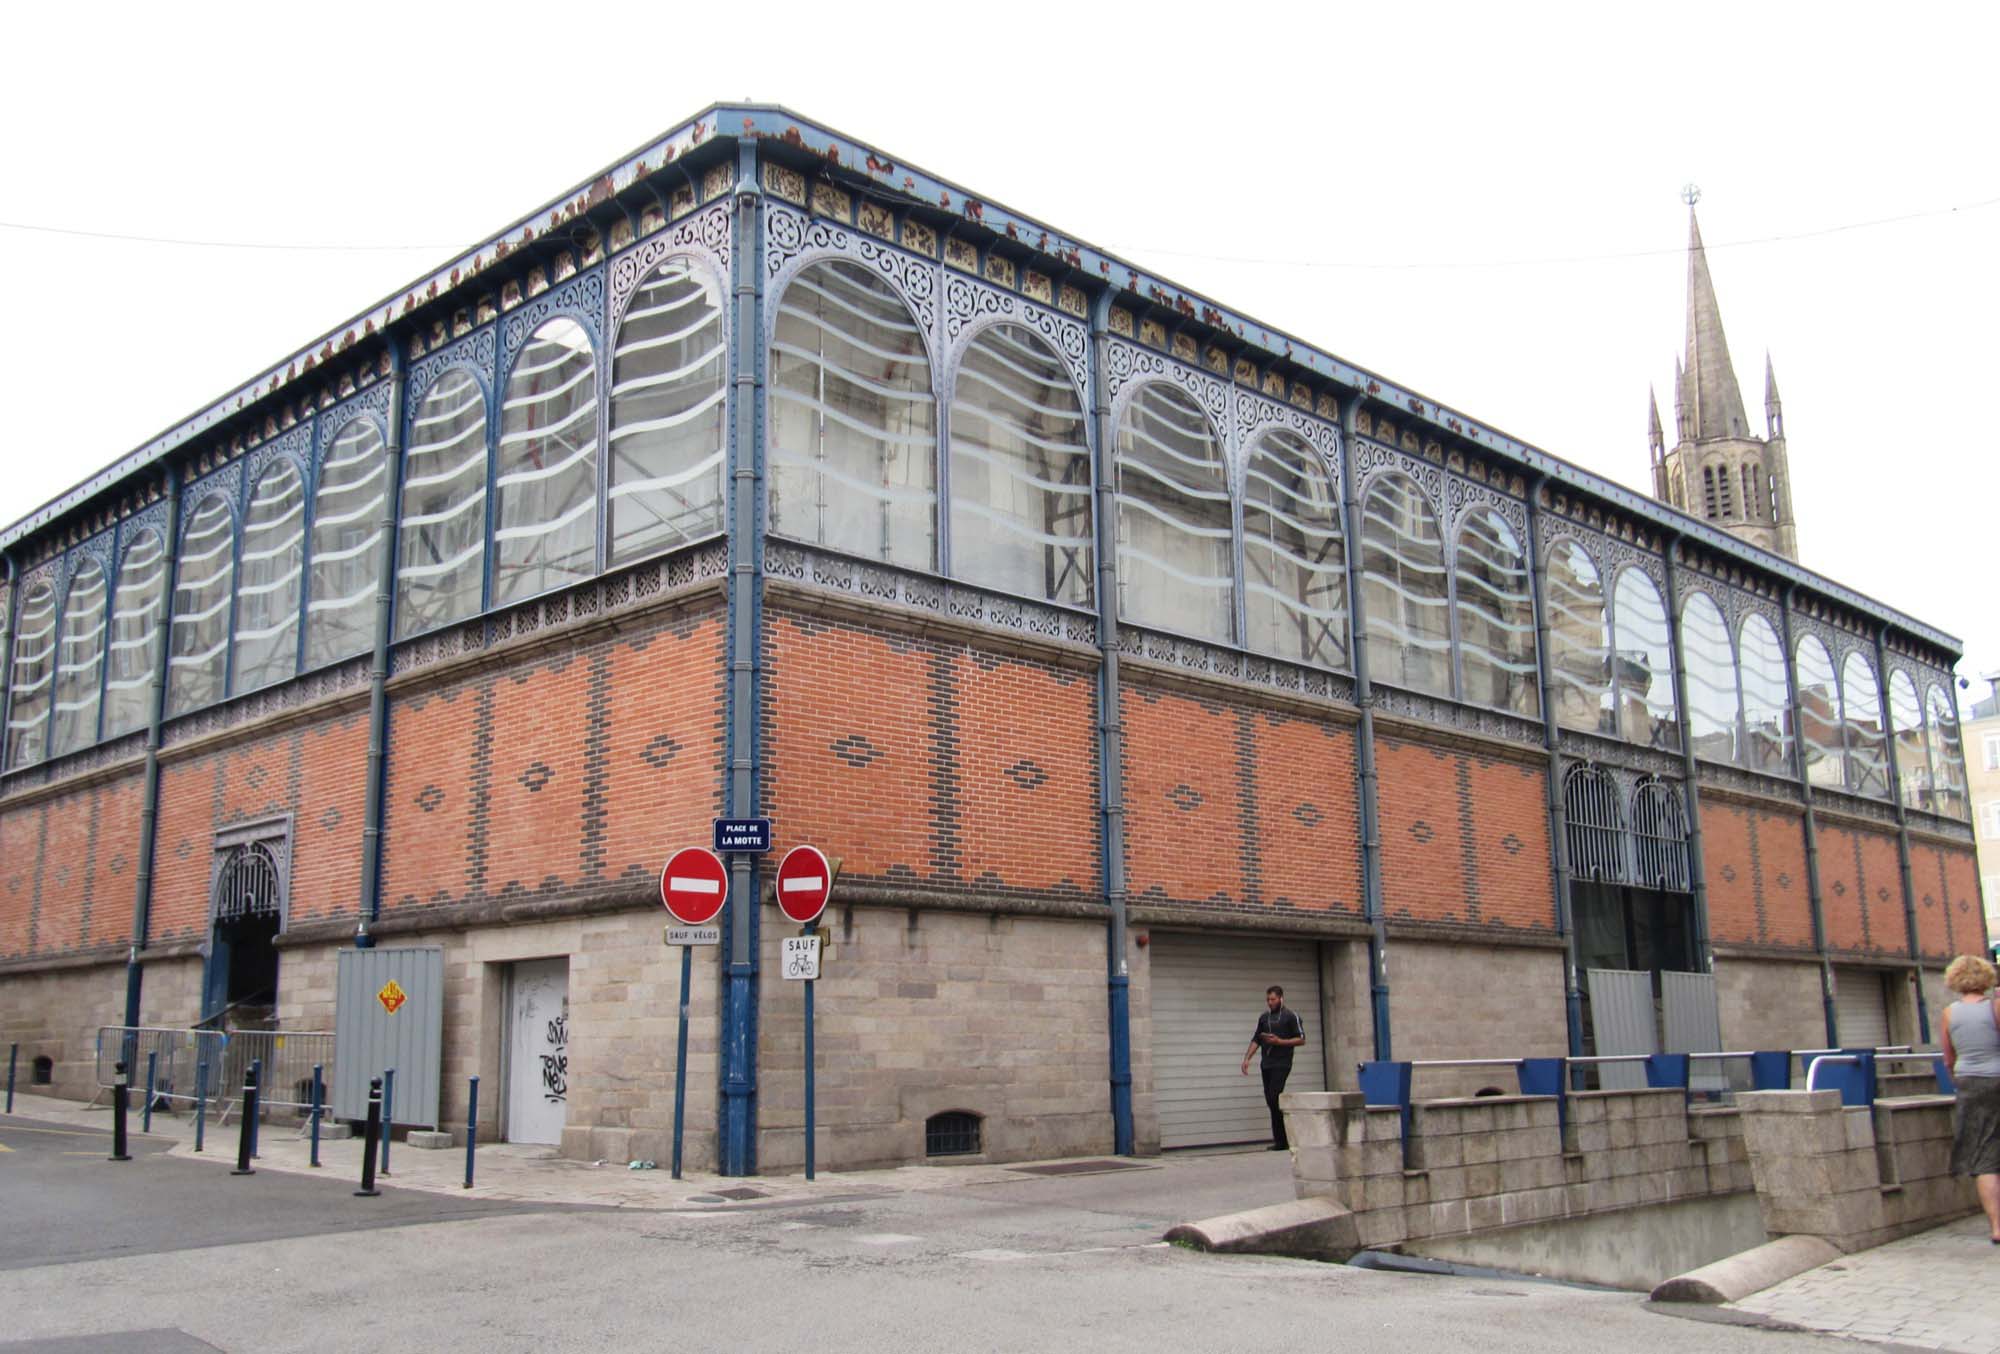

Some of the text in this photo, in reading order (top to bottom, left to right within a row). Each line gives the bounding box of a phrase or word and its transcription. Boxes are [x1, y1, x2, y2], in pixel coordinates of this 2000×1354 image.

[722, 837, 762, 845] LA MOTTE
[670, 930, 718, 939] SAUF VÉLOS
[789, 940, 815, 951] SAUF
